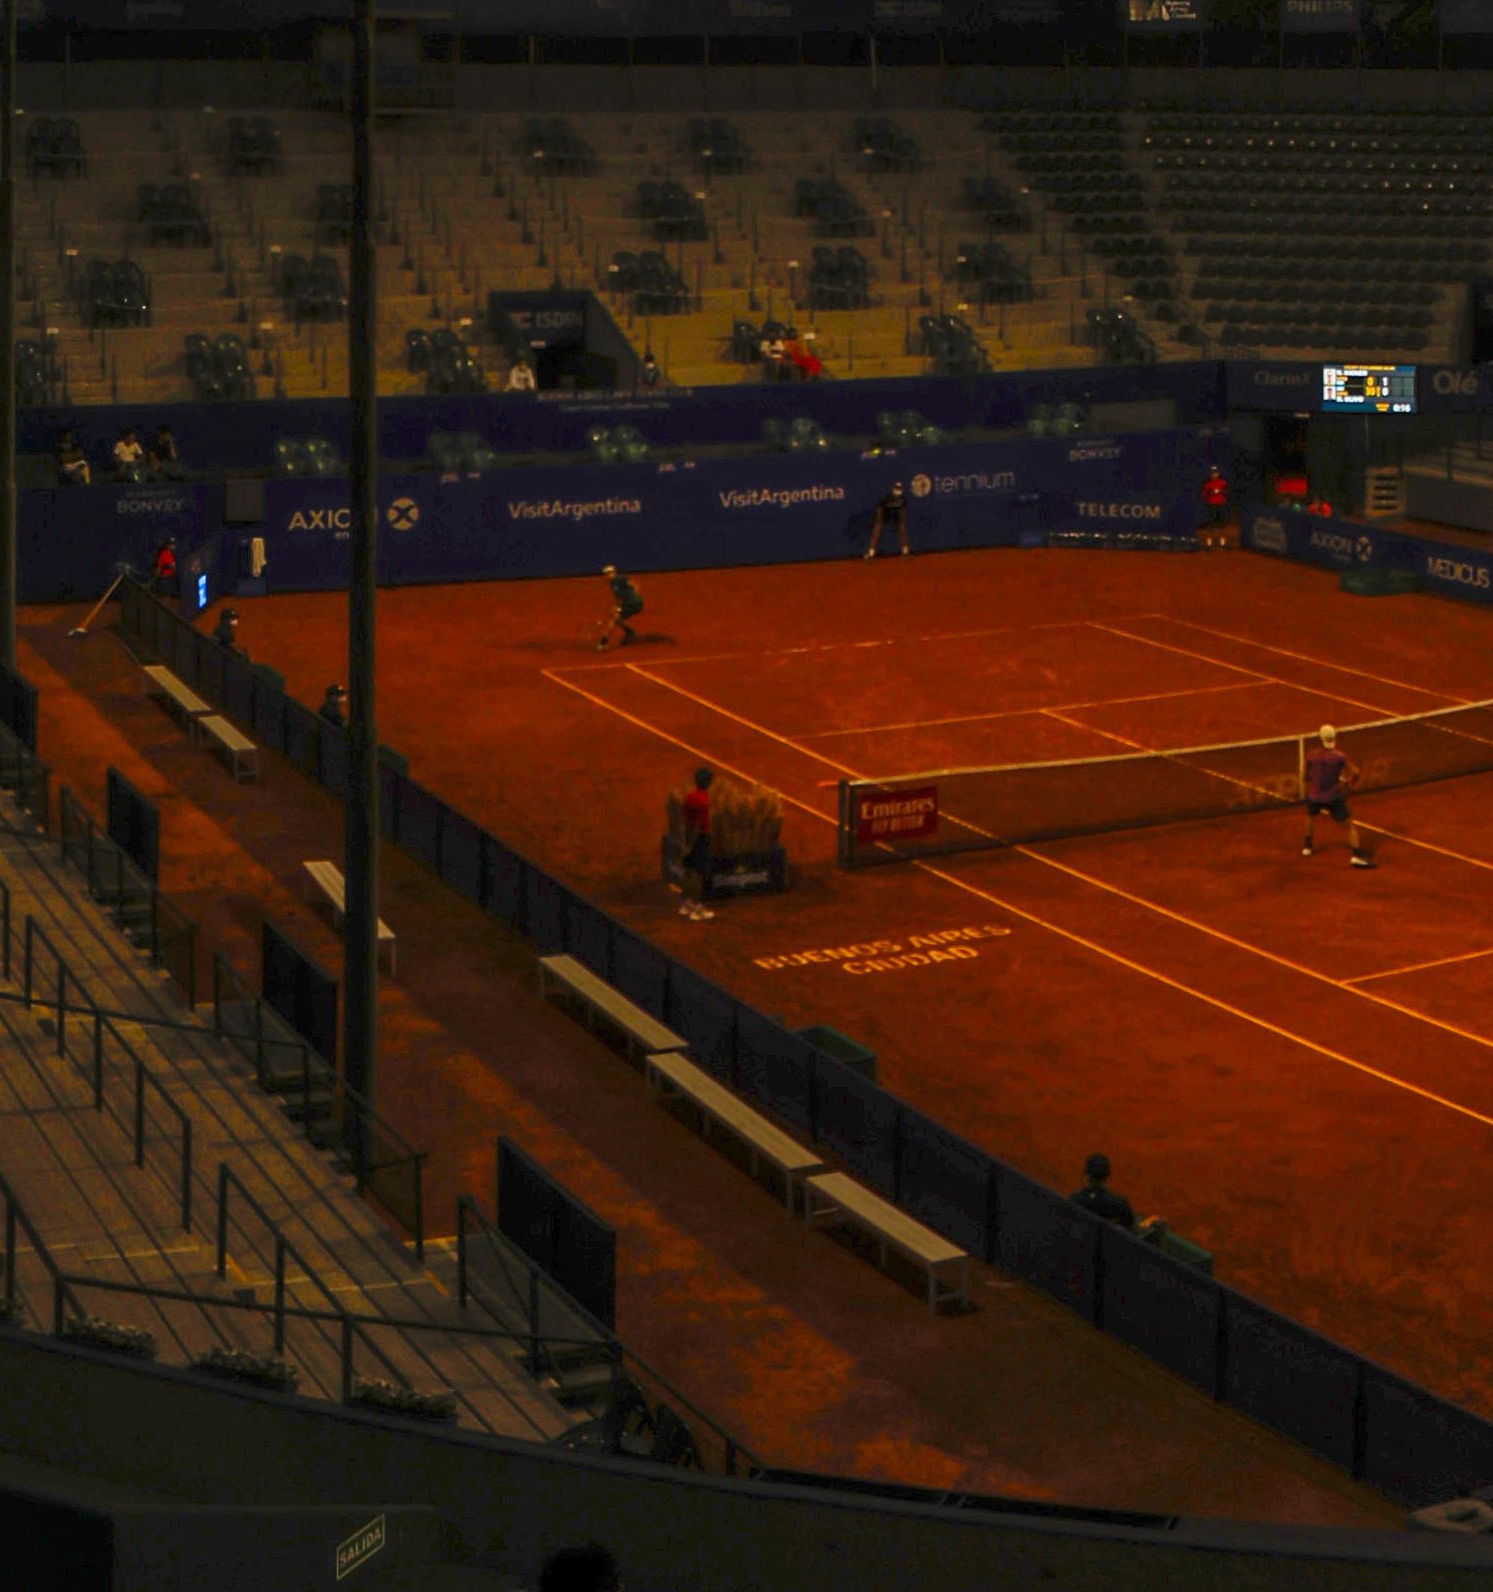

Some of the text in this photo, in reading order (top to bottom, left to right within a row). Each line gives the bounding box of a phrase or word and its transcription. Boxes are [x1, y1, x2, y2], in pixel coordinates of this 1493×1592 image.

[1433, 368, 1479, 396] Olé
[934, 471, 1016, 495] tennium
[718, 484, 845, 509] VisitArgentina
[288, 508, 374, 530] AXIO
[508, 498, 642, 521] VisitArgentina
[1076, 502, 1161, 519] TELECOM
[1427, 556, 1491, 589] MEDICUS
[862, 799, 935, 820] Emirates
[754, 940, 902, 970] BUENOS
[842, 945, 979, 974] CIUDAD
[339, 1527, 382, 1568] SALIDA
